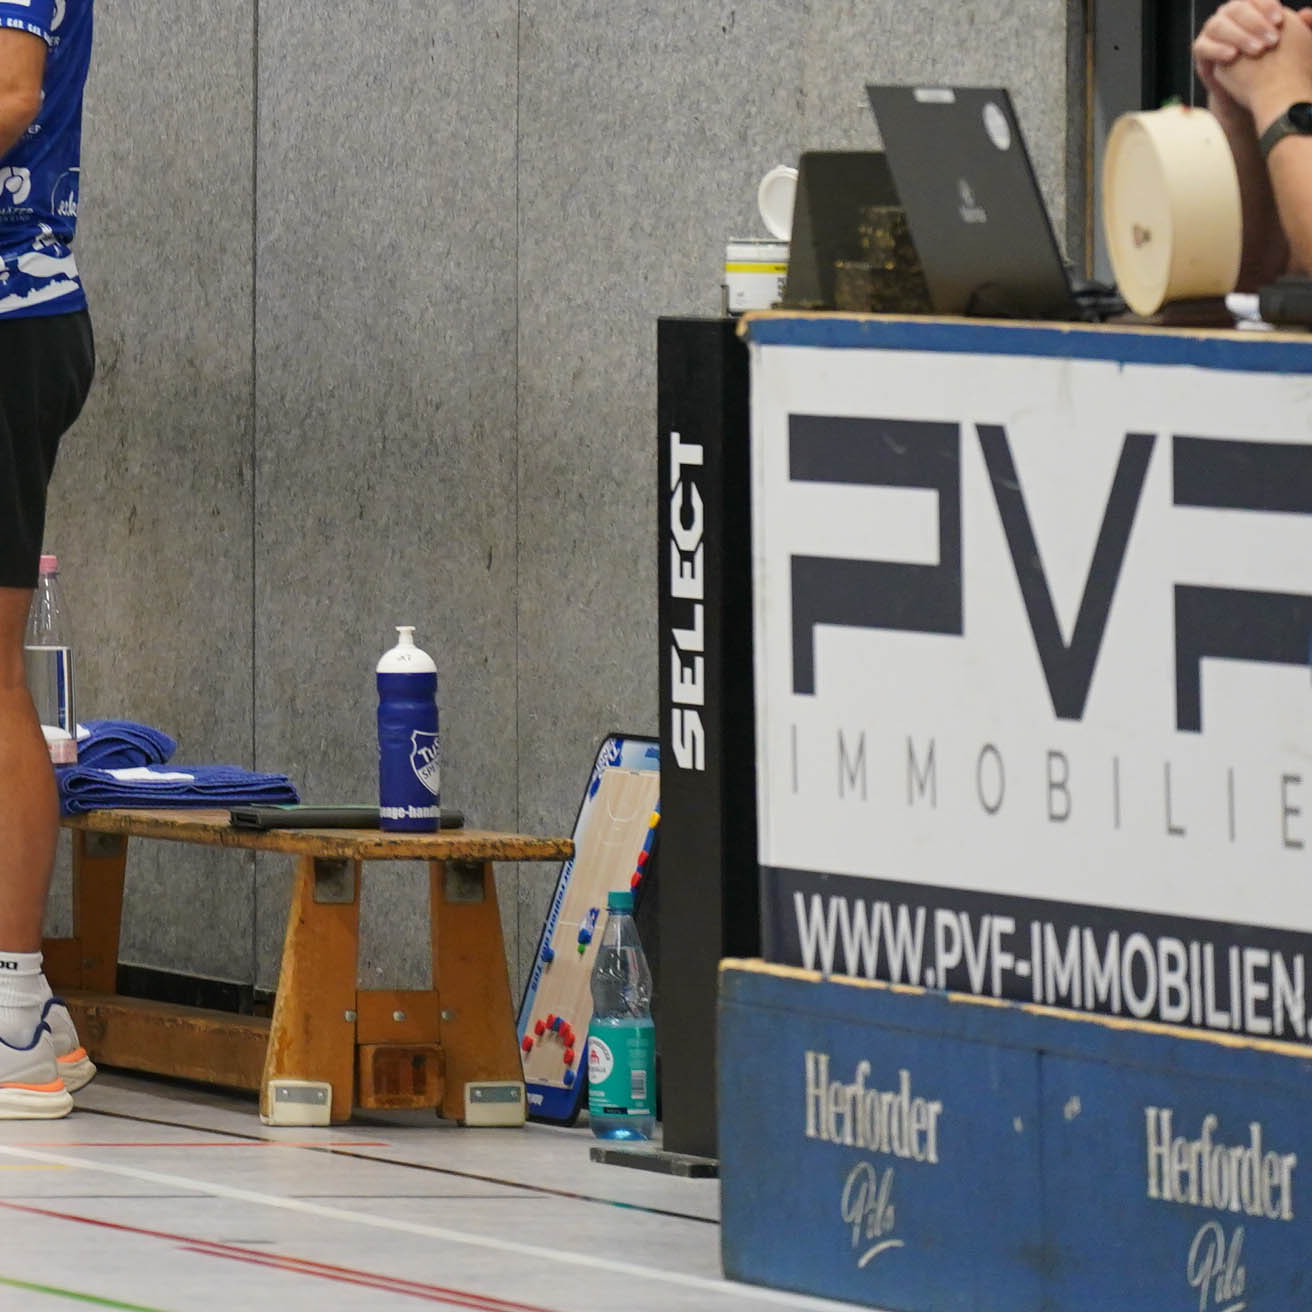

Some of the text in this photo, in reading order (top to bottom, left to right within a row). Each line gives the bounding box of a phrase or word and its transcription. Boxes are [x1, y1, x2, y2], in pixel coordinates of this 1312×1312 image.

[670, 432, 705, 771] SELECT
[805, 1051, 942, 1164] Herforder
[1145, 1105, 1297, 1221] Herforder
